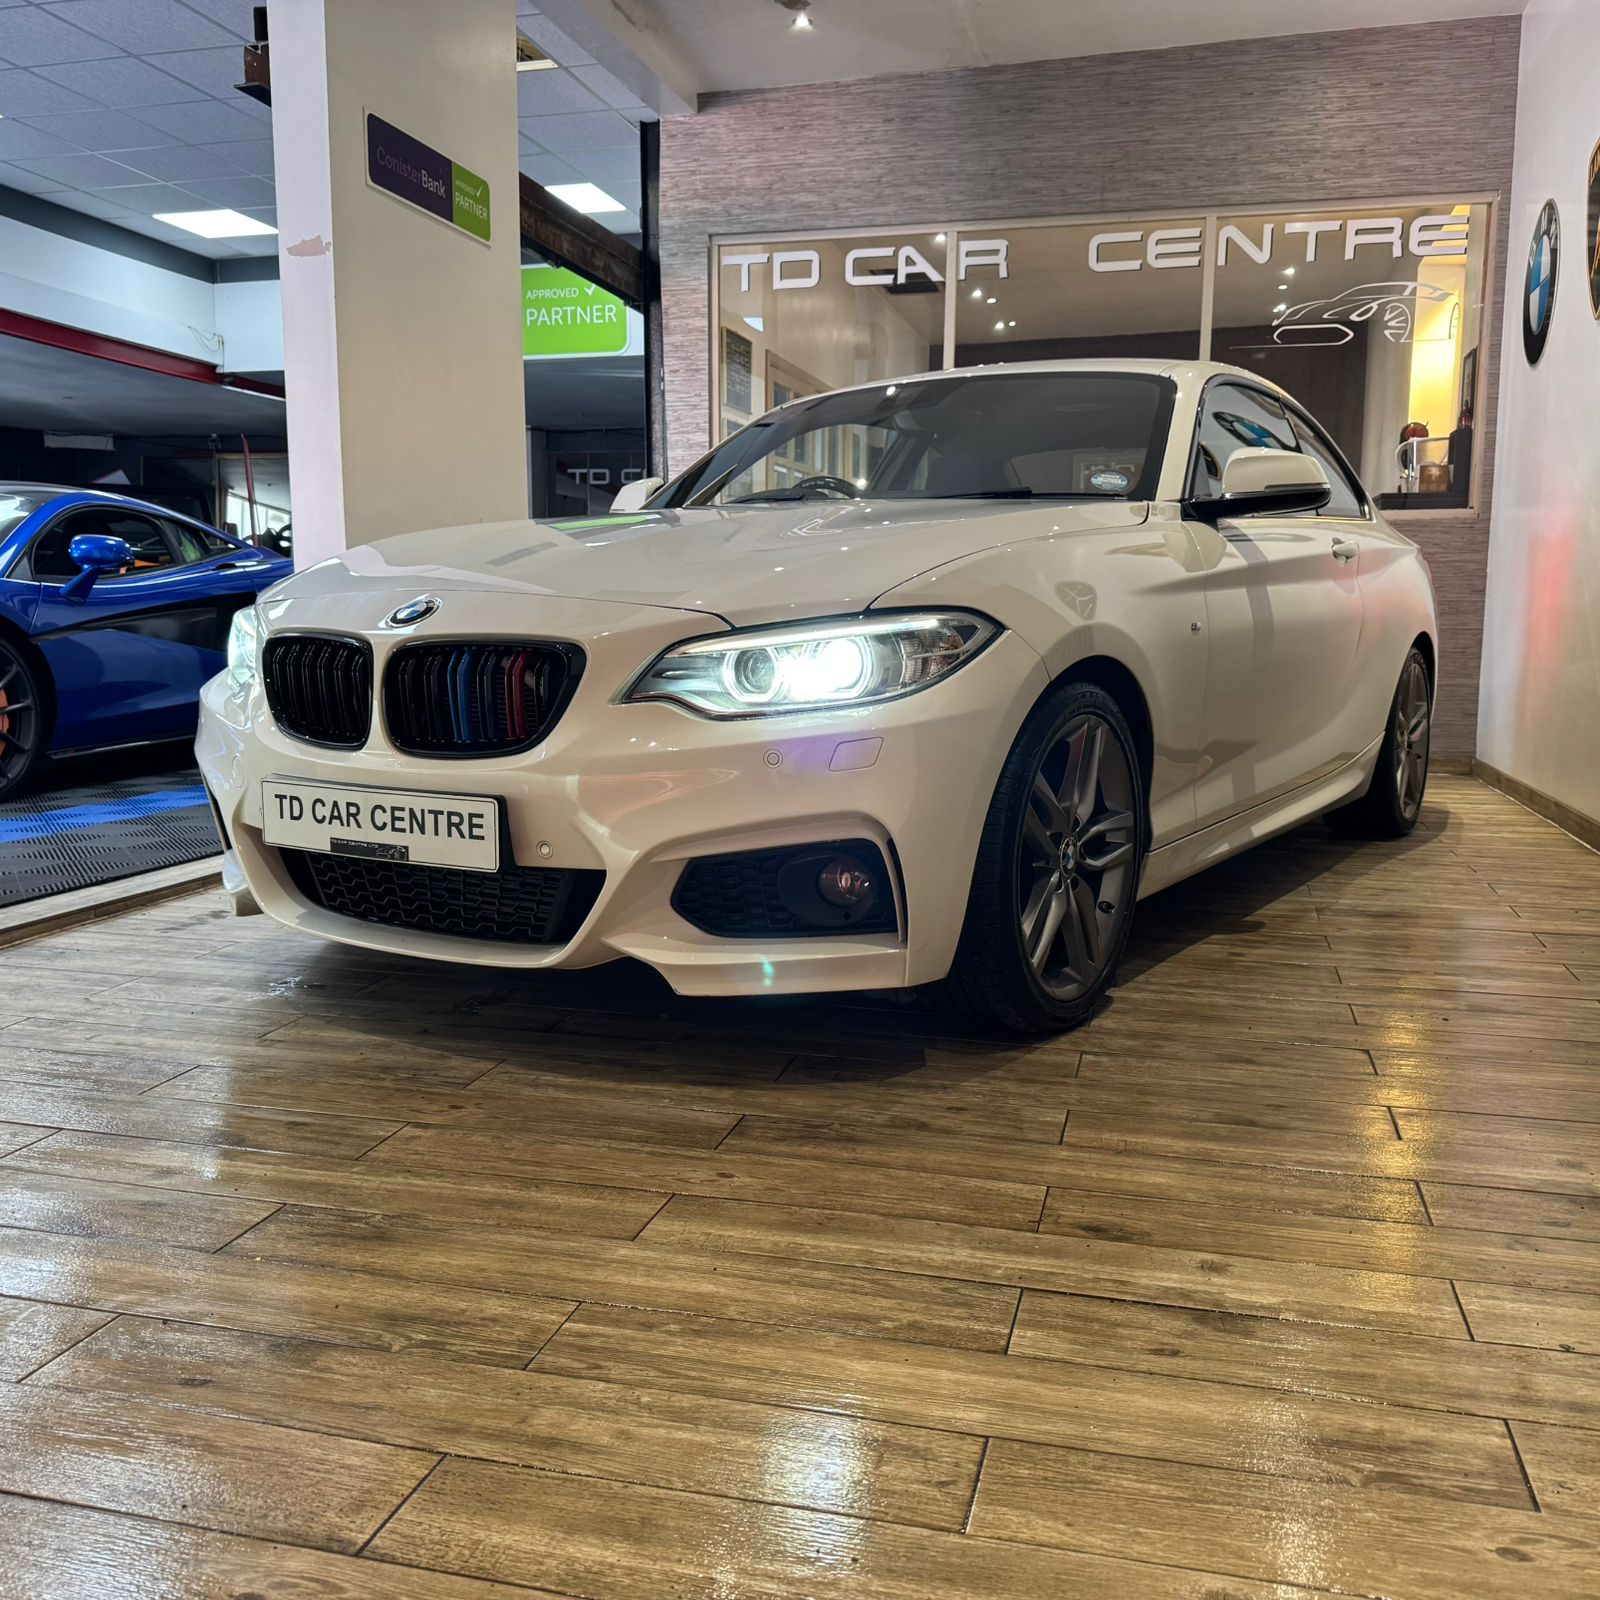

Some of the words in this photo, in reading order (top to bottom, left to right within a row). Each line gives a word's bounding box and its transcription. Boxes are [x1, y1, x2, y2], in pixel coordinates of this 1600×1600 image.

[376, 146, 446, 199] ConisterBank
[455, 191, 488, 220] PARTNER
[722, 250, 820, 293] TD
[845, 239, 1009, 286] CAR
[1088, 215, 1470, 273] CENTRE
[526, 287, 579, 300] APPROVED
[526, 304, 617, 327] PARTNER
[567, 468, 610, 485] TD
[274, 793, 304, 821] TD
[311, 798, 362, 829] CAR
[370, 804, 485, 841] CENTRE
